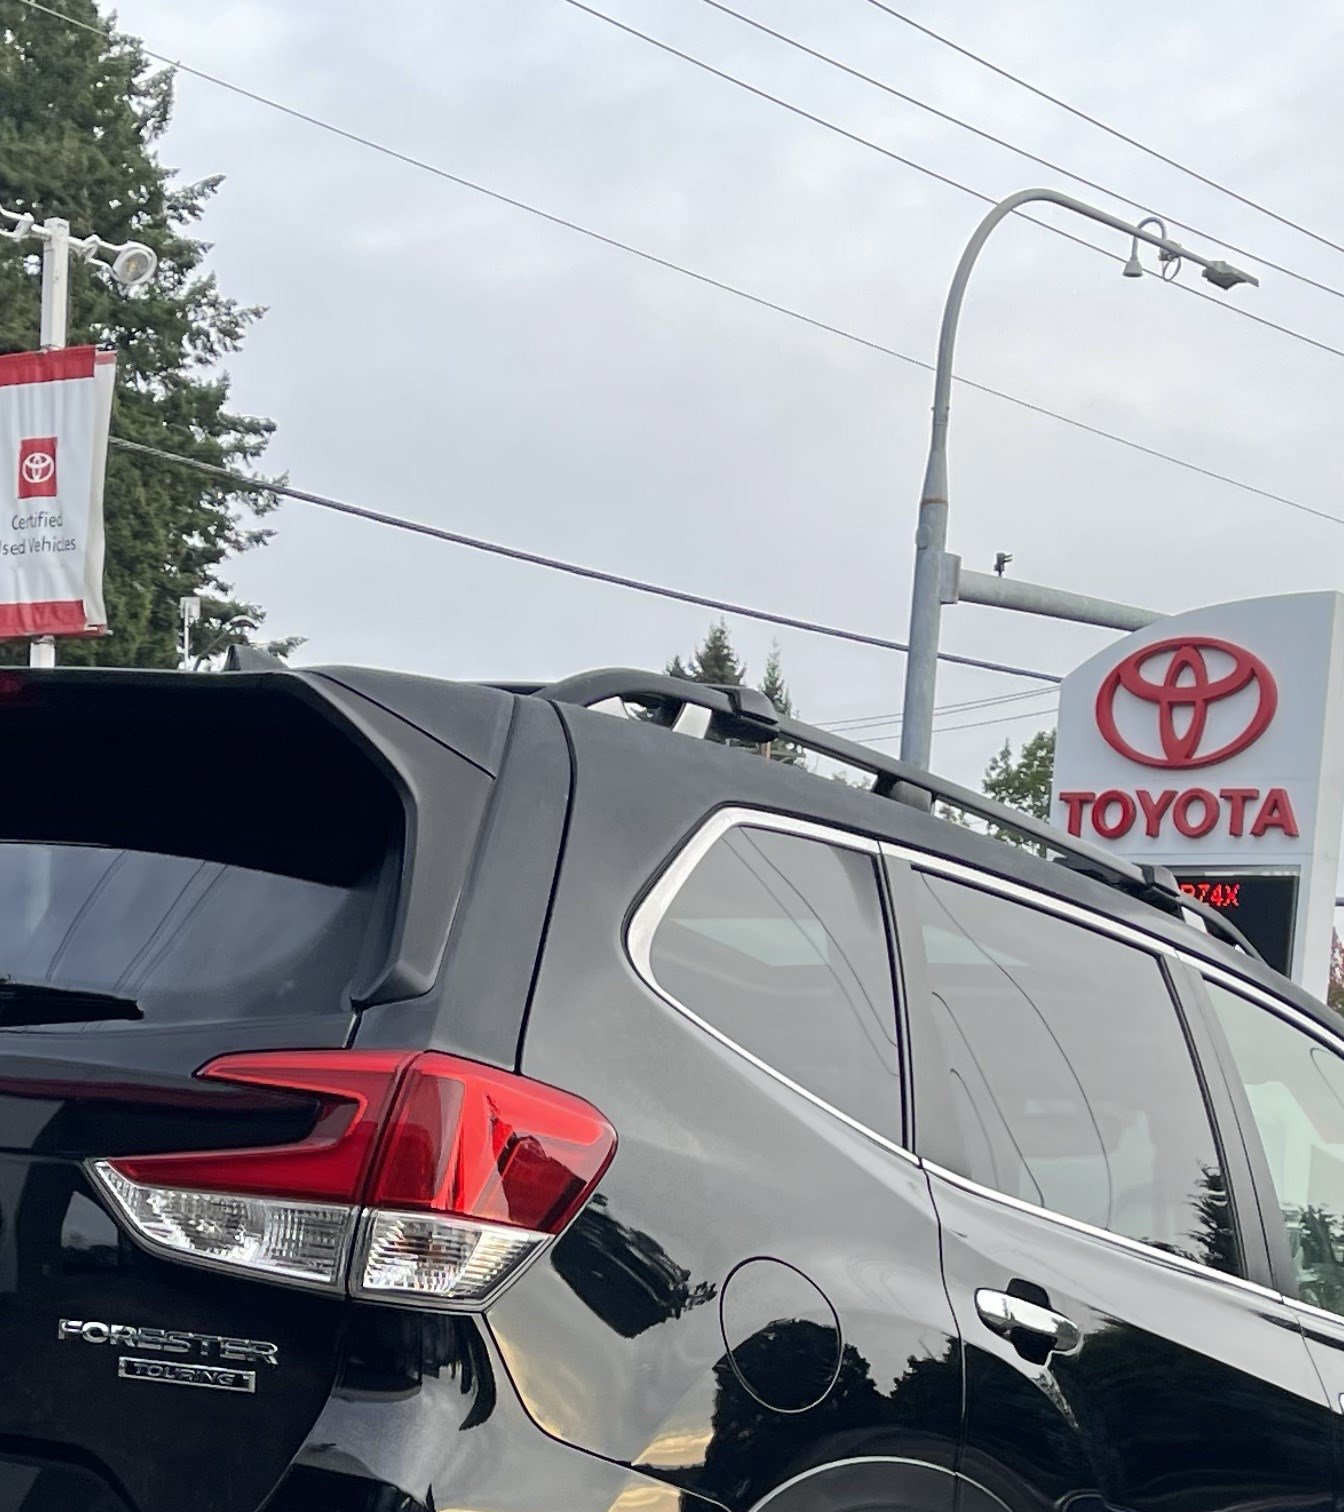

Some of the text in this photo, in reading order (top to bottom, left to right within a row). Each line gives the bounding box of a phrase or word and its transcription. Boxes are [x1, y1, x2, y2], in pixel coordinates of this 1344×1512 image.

[11, 511, 64, 531] Certified
[28, 535, 77, 555] Vehicles
[1059, 787, 1300, 839] TOYOTA
[58, 1318, 279, 1368] FORESTER
[132, 1362, 236, 1385] TOURING
